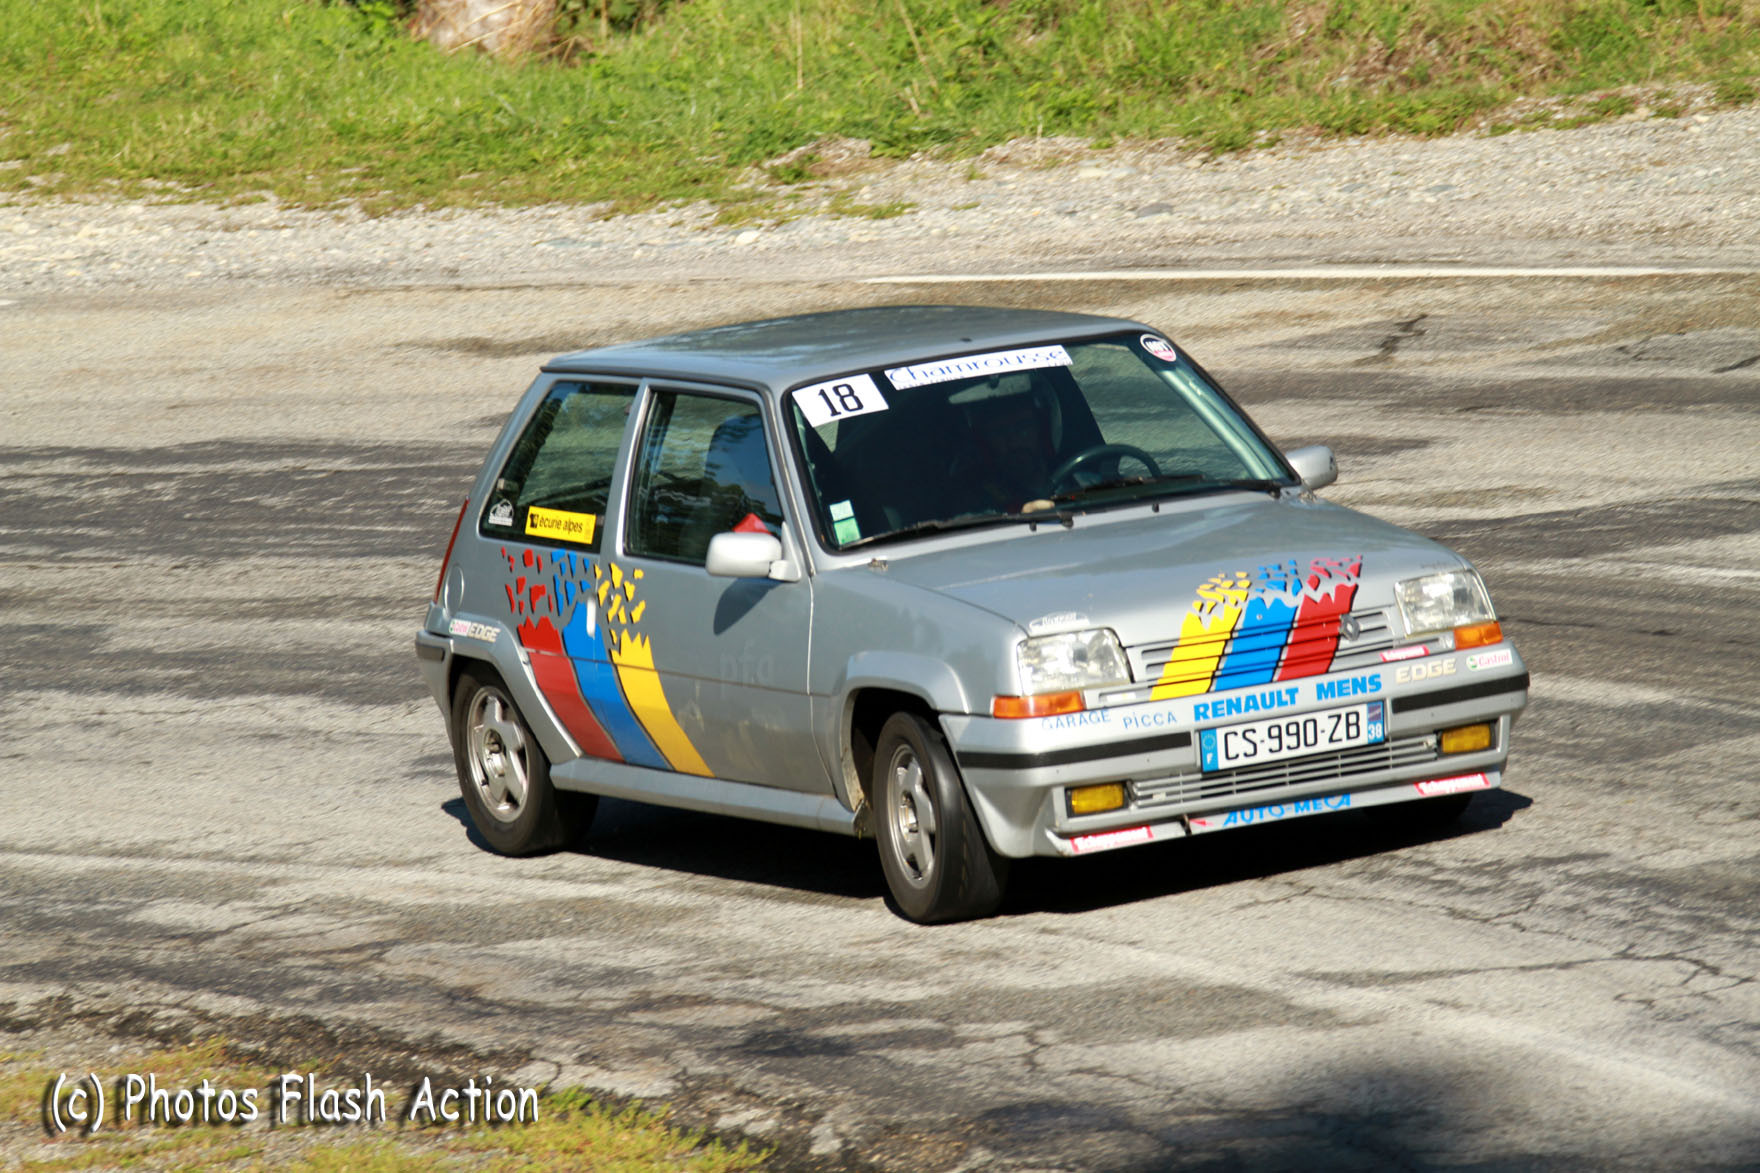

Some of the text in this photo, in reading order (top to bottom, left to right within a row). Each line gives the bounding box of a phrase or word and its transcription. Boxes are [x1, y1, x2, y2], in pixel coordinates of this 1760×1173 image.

[889, 350, 1063, 382] Chamrousse
[818, 383, 864, 417] 18
[563, 516, 584, 534] alpes
[468, 622, 501, 642] EDGE
[1395, 657, 1457, 683] EDGE
[1478, 652, 1510, 667] Castrol
[1193, 673, 1382, 722] RENAULT MENS
[1041, 708, 1112, 730] GARAGE
[1368, 722, 1382, 739] 38
[1223, 711, 1361, 761] CS-990-ZB
[1223, 793, 1351, 827] AUTO-MECA
